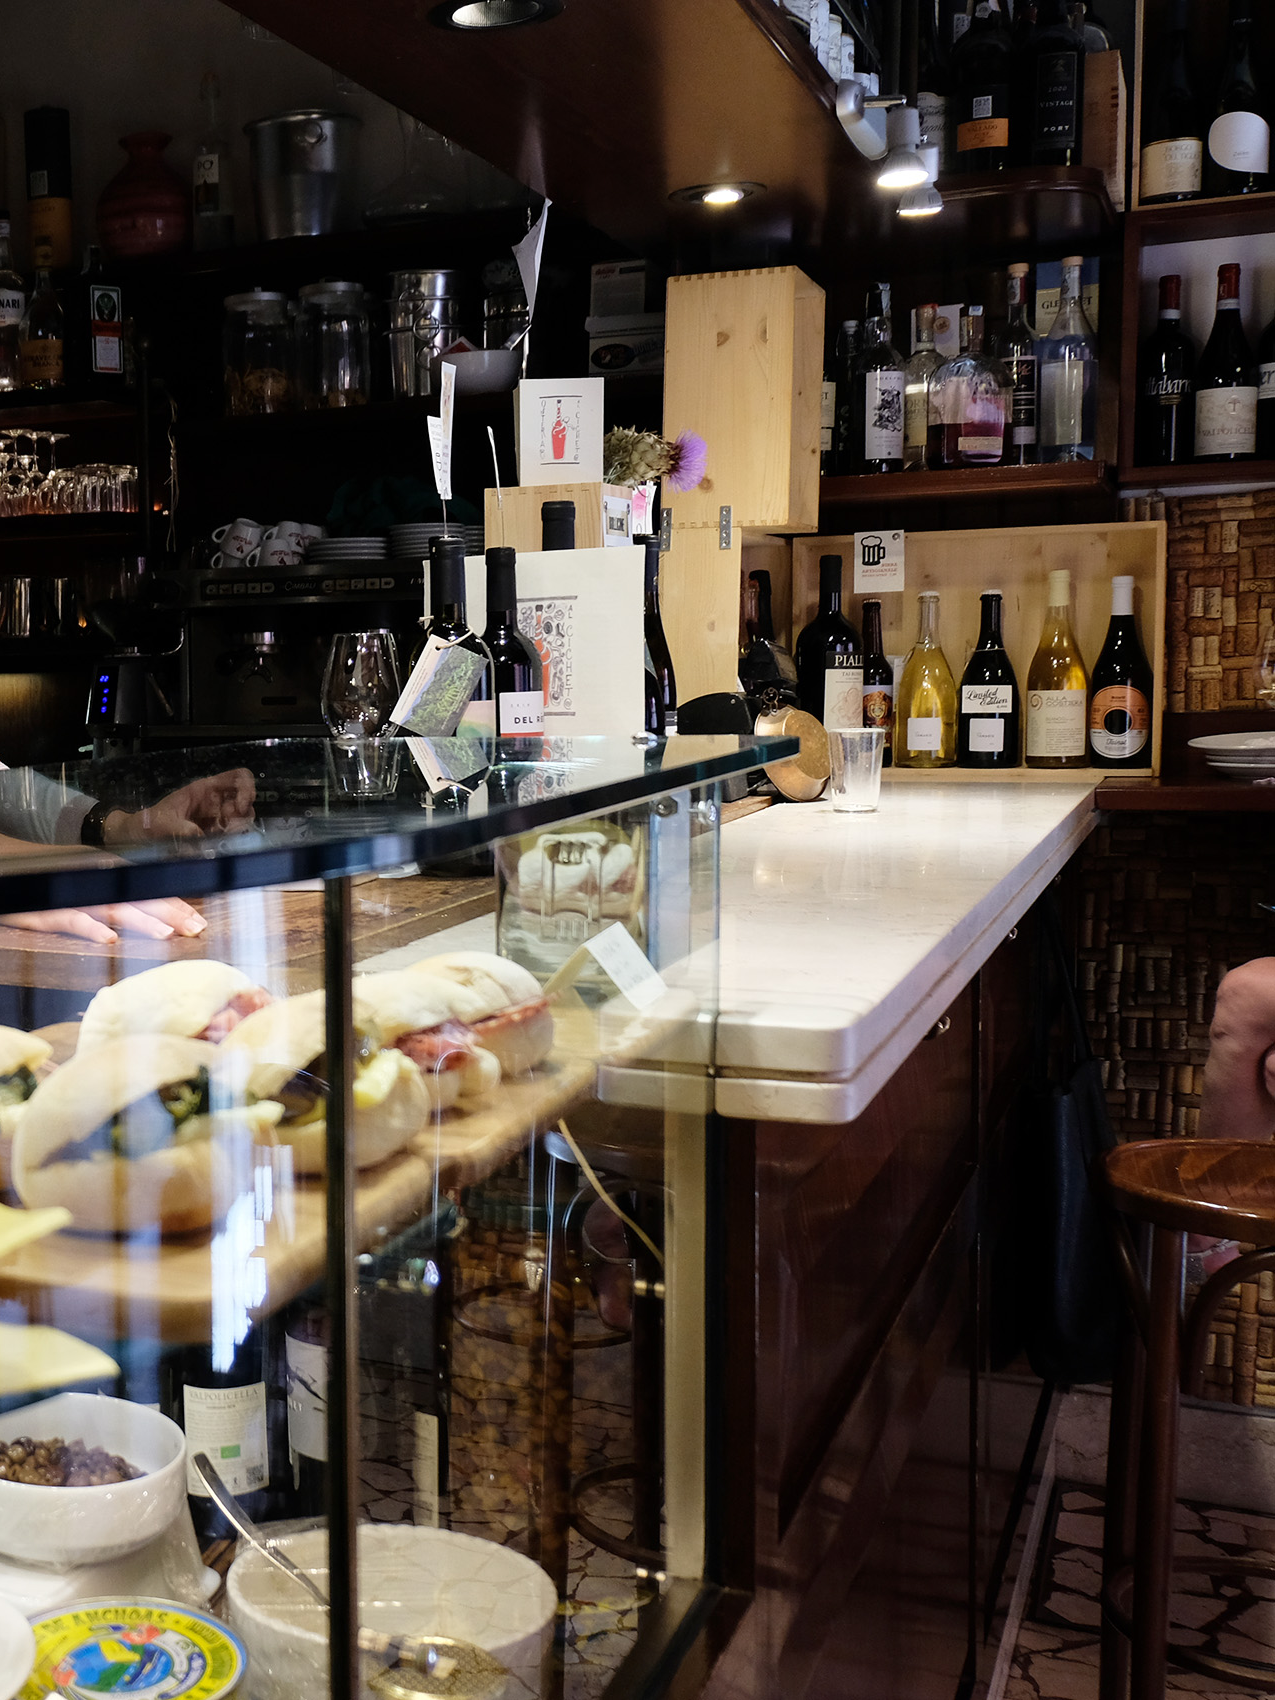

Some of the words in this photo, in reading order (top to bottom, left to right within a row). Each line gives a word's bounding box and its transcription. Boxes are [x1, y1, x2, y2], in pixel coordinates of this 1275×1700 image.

[1039, 100, 1073, 108] VINTAGE
[563, 624, 573, 710] CICHETO
[965, 688, 998, 701] Limited
[980, 697, 1008, 706] Edition
[514, 716, 533, 724] DEL
[189, 1387, 259, 1402] VALPOLICELLA
